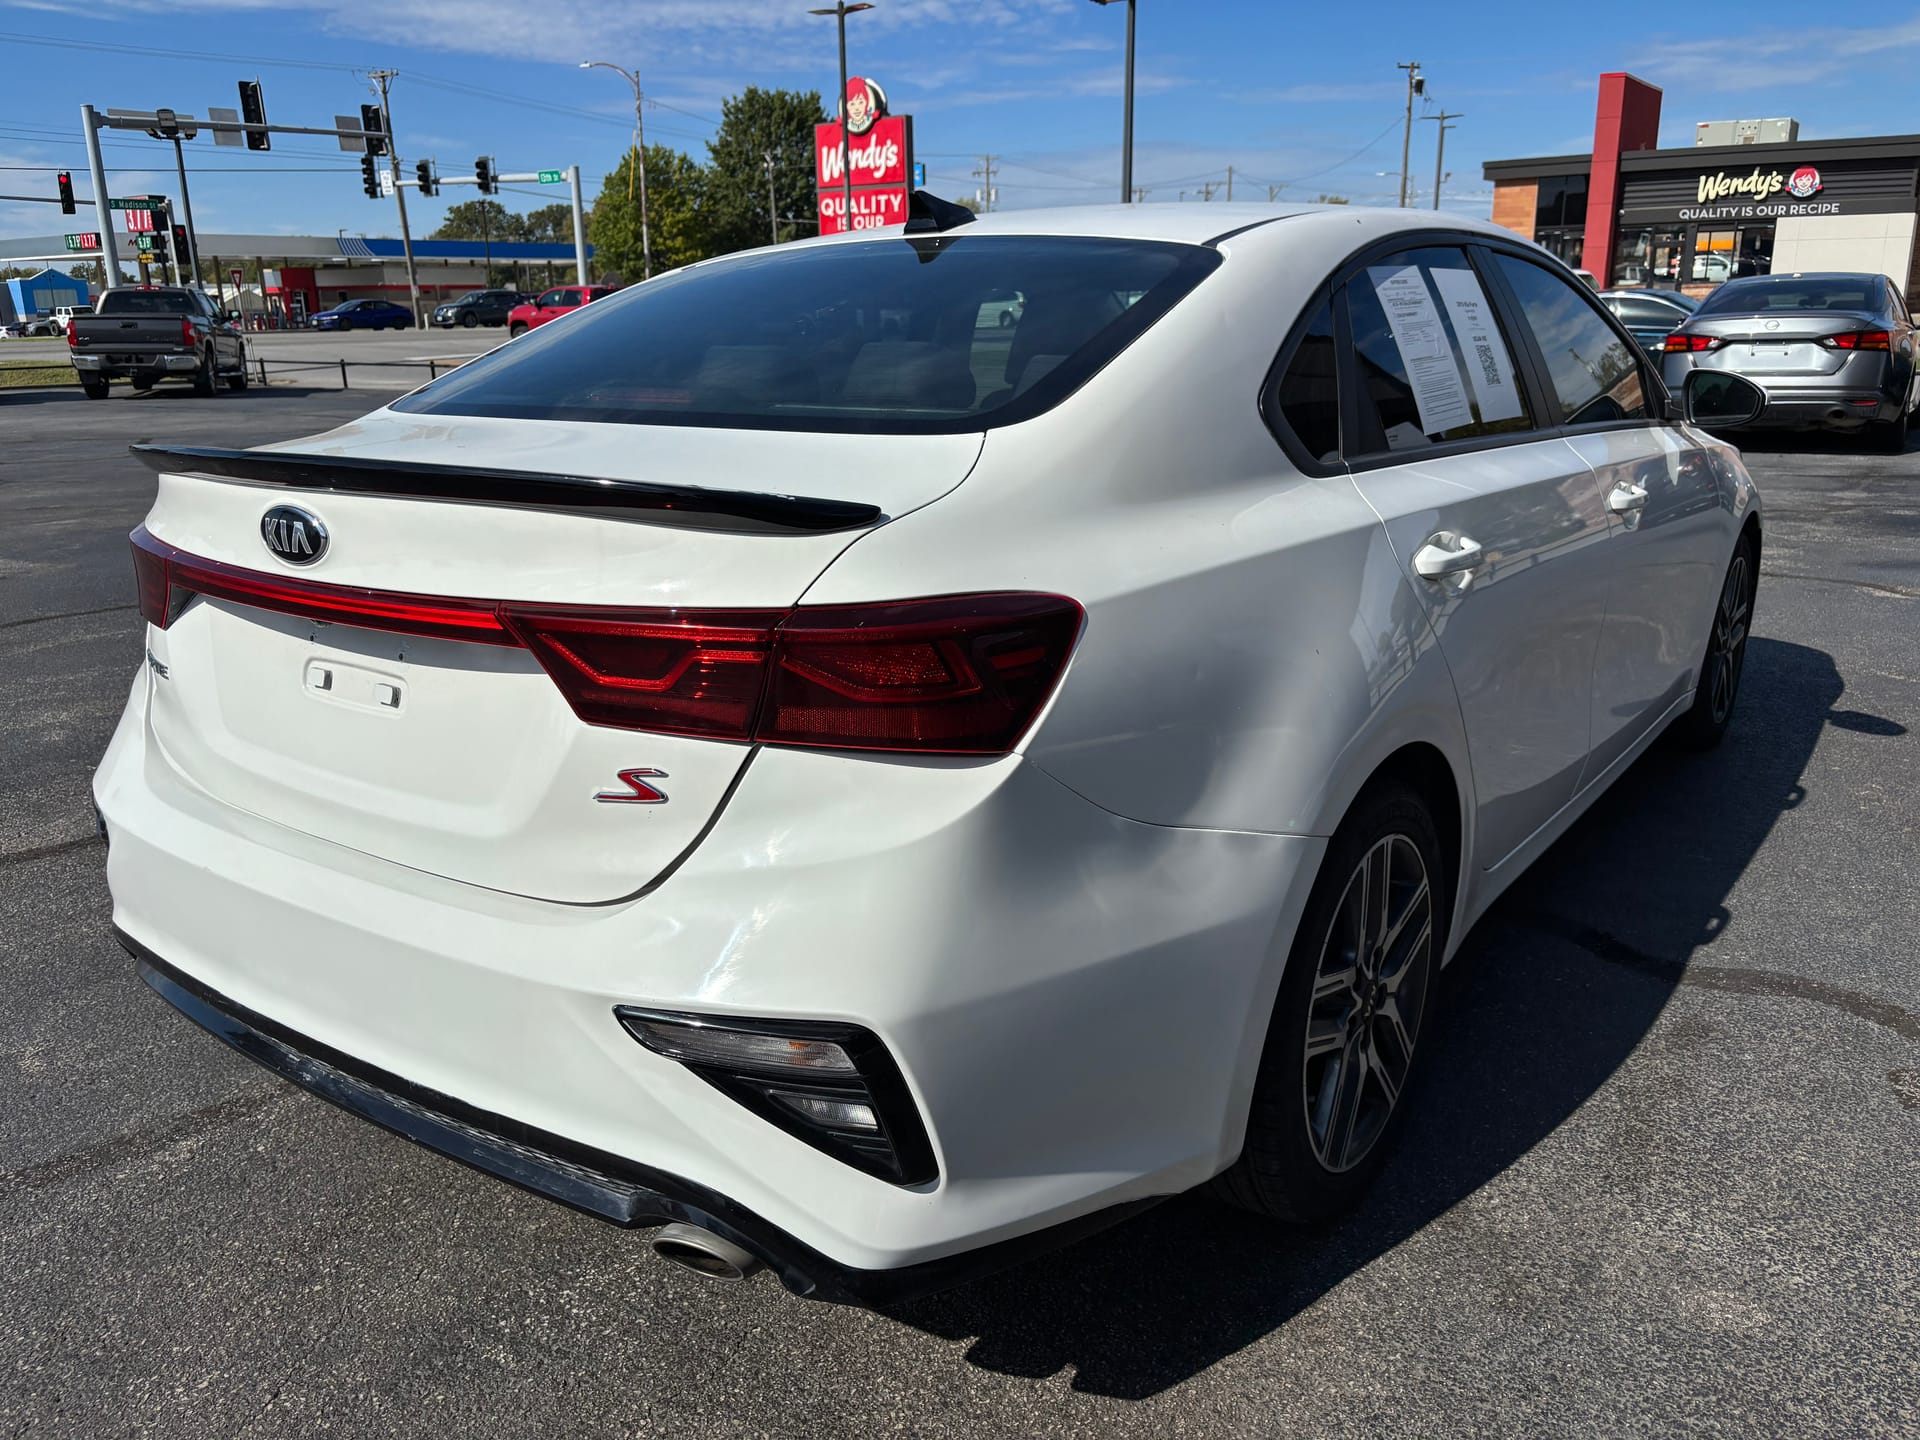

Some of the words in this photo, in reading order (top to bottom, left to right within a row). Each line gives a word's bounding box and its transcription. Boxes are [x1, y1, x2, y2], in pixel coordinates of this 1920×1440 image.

[1698, 166, 1783, 203] Wendy's
[820, 194, 903, 217] QUALITY
[1678, 207, 1739, 220] QUALITY
[1741, 205, 1753, 217] IS
[1756, 204, 1786, 217] OUR
[1789, 202, 1841, 215] RECIPE
[264, 517, 313, 554] KIA
[592, 767, 670, 804] S
